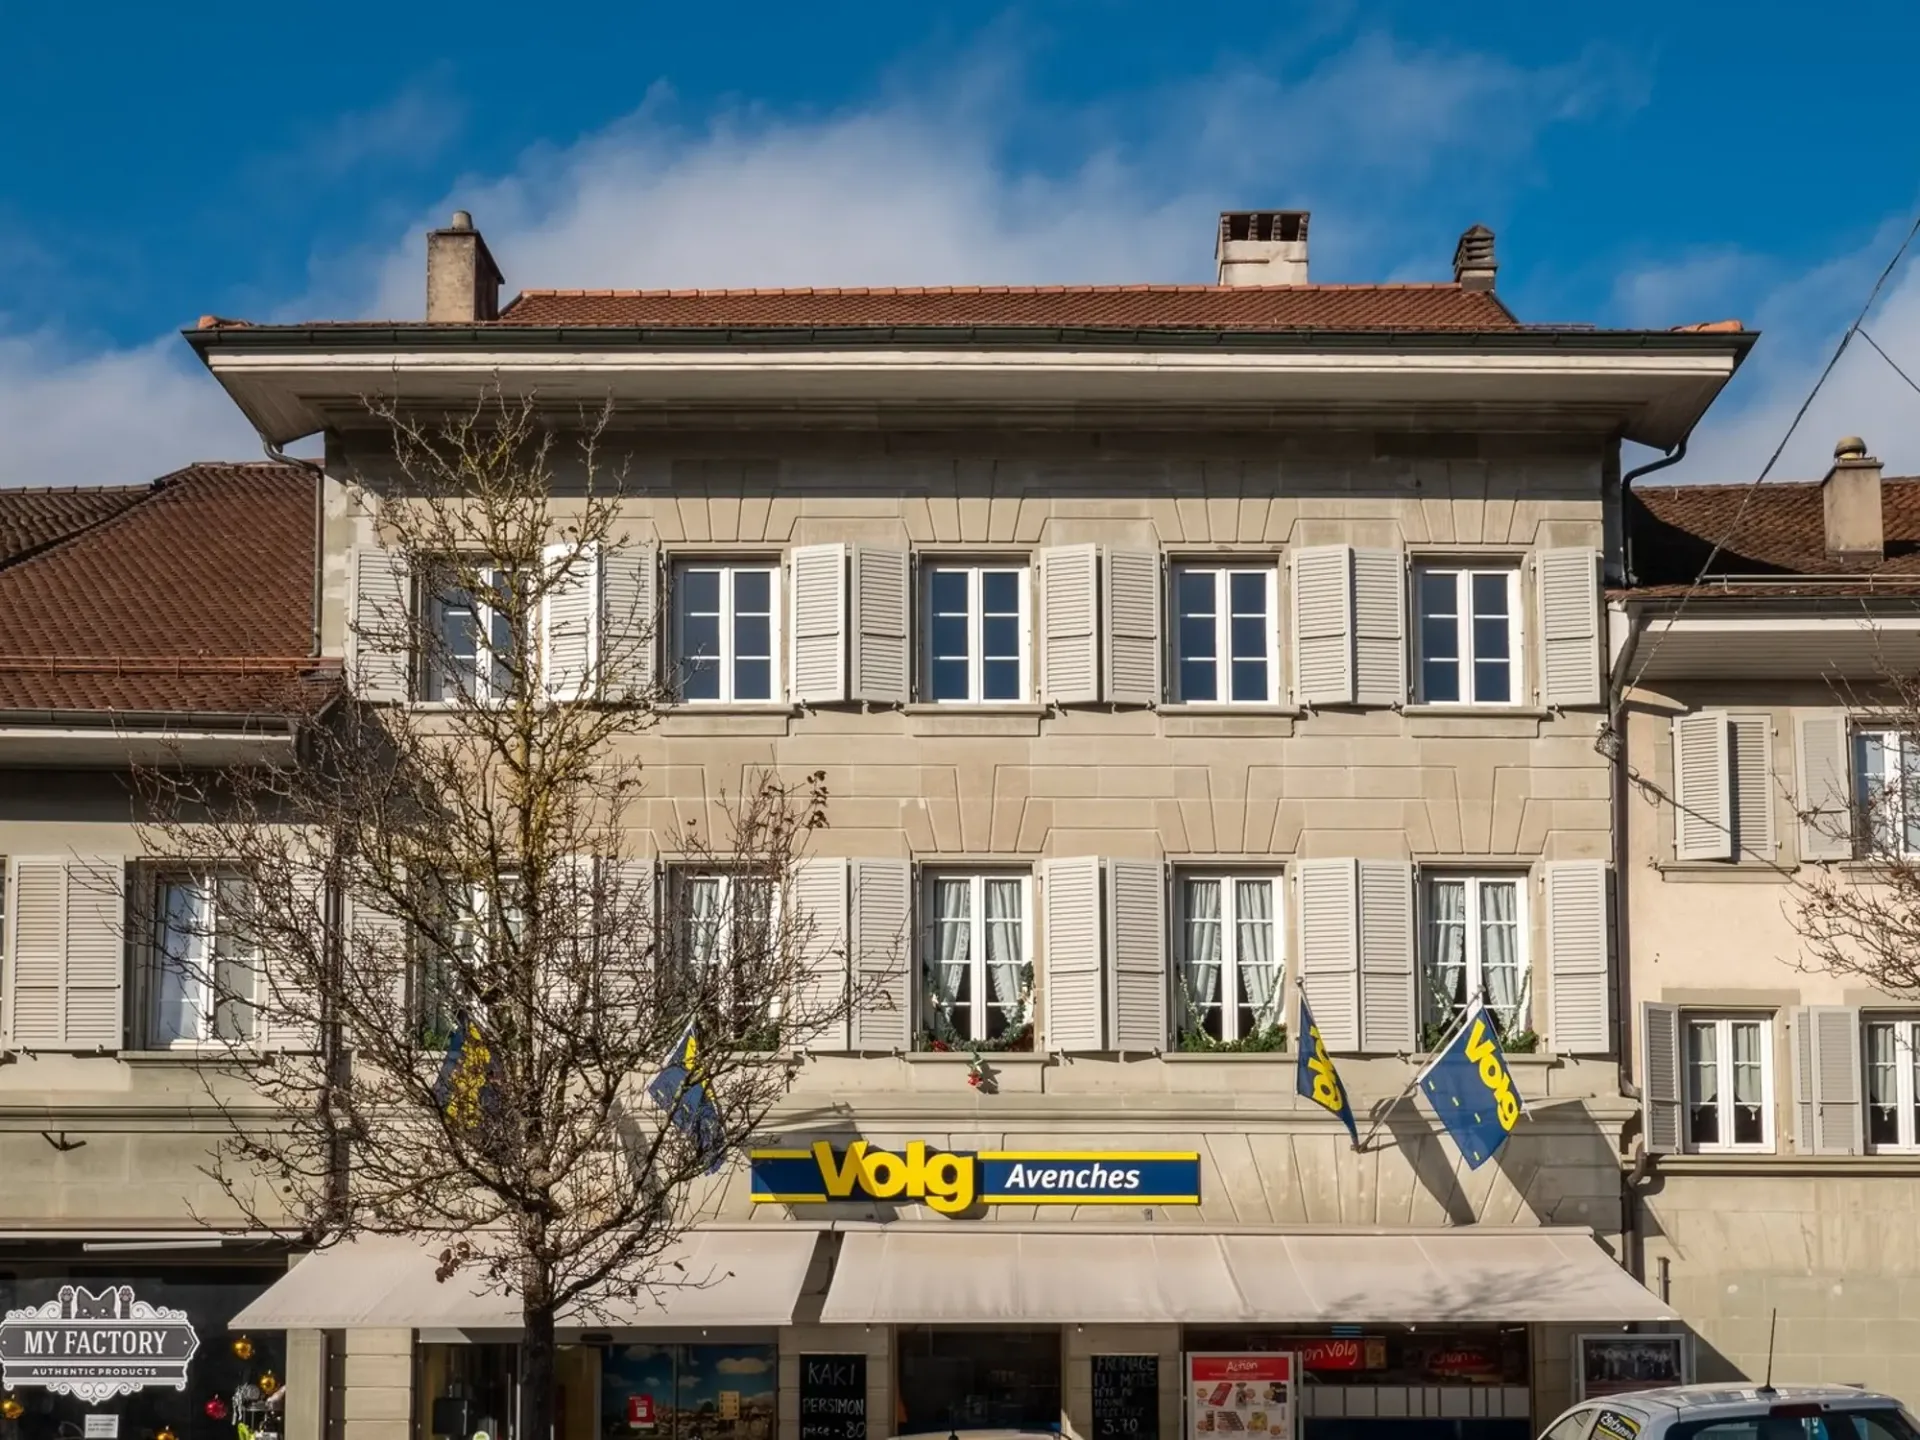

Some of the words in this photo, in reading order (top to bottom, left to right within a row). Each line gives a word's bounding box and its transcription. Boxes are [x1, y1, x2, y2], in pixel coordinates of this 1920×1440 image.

[1465, 1018, 1519, 1132] Volg
[812, 1139, 974, 1213] Volg
[1004, 1163, 1140, 1189] Avenches
[24, 1330, 58, 1355] MY
[64, 1330, 167, 1355] FACTORY
[1325, 1340, 1358, 1366] Volg
[32, 1367, 97, 1376] AUTHENTIC
[98, 1367, 157, 1376] PRODUCTS
[808, 1361, 855, 1386] KAKI
[1226, 1361, 1258, 1373] Action
